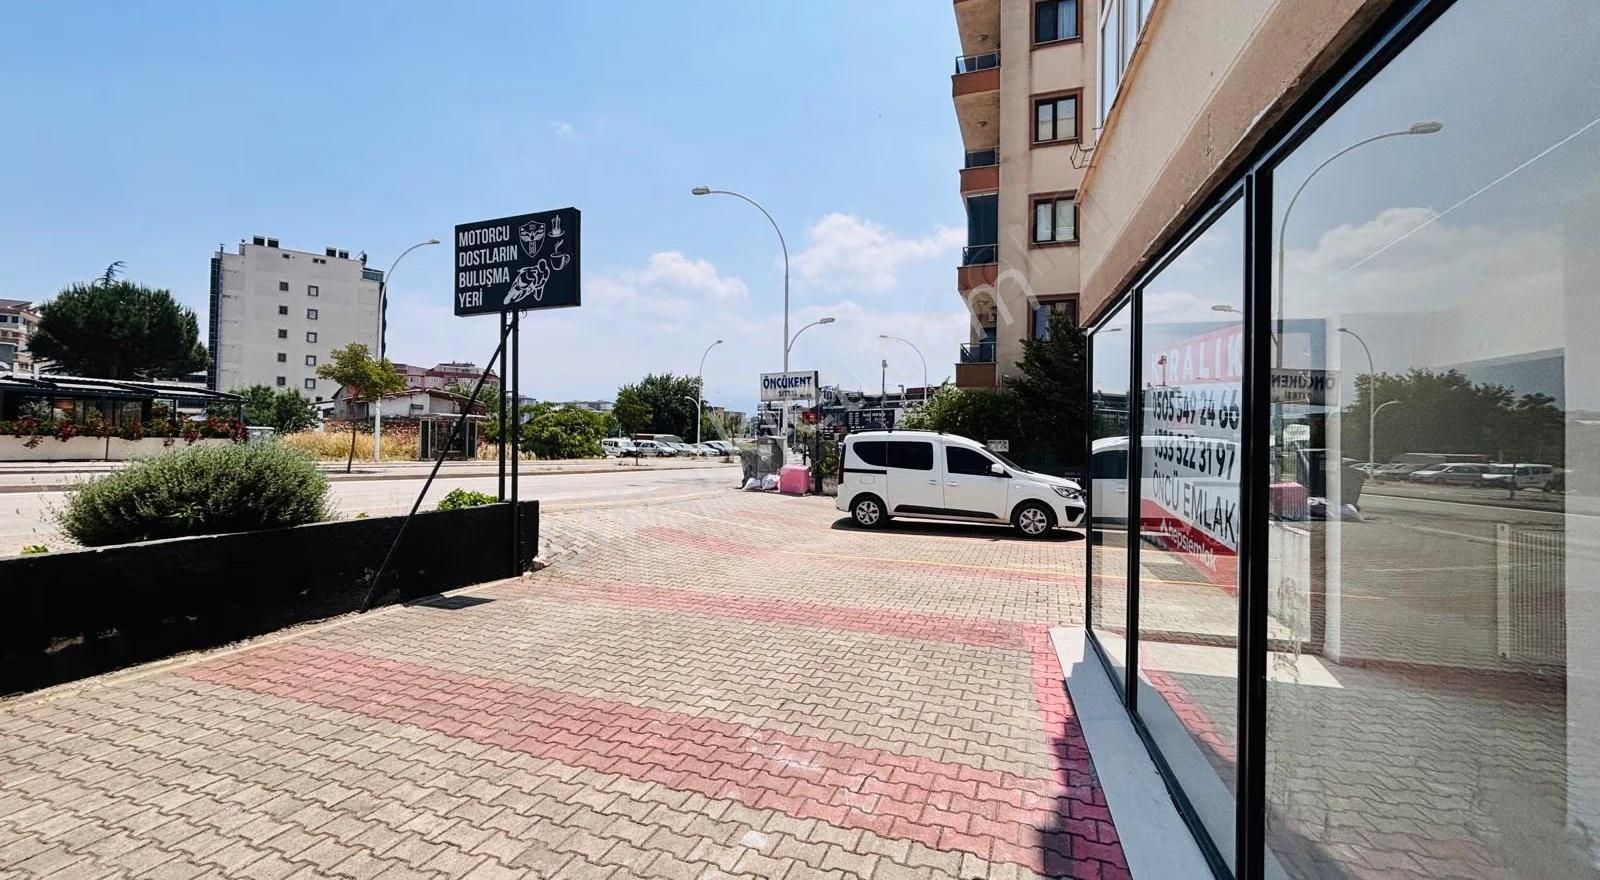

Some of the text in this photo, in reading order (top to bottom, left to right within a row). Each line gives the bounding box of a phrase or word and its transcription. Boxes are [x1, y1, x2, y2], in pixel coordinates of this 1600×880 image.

[459, 225, 510, 247] MOTORCU
[459, 245, 518, 267] DOSTLARIN
[459, 267, 510, 288] BULUŞMA
[459, 288, 483, 308] YERİ
[763, 375, 812, 389] ÖNCÜKENT
[1153, 390, 1174, 421] 0505
[1199, 390, 1215, 427] 24
[1218, 389, 1240, 430] 66
[1154, 428, 1236, 480] 0333 522 31 97
[1153, 462, 1236, 544] ÖNCÜ EMLAK
[1168, 521, 1217, 572] hepsiemlak
